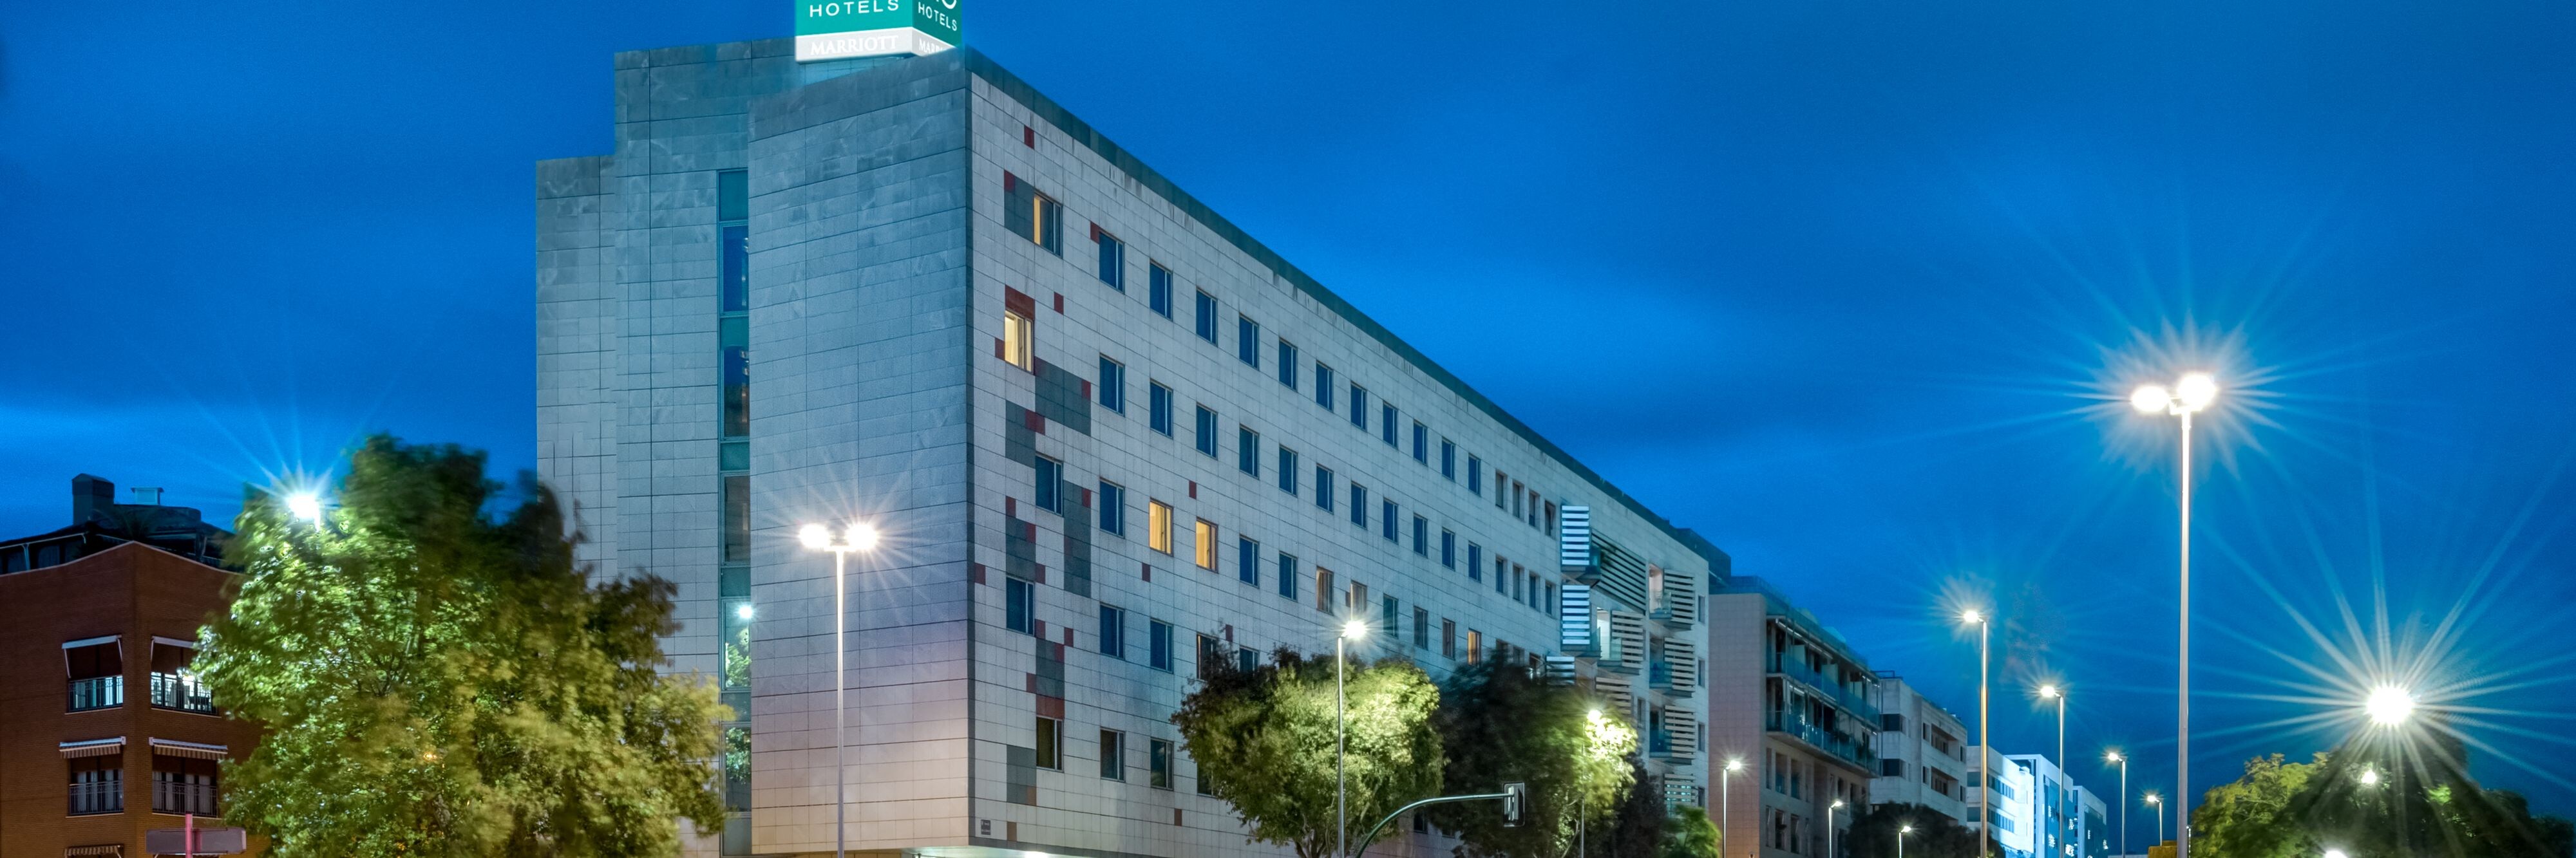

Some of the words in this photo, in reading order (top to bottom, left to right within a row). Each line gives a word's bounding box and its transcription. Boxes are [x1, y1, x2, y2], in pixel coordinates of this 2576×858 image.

[810, 0, 899, 17] HOTELS
[918, 1, 957, 32] HOTELS
[810, 35, 899, 55] MARRIOTT
